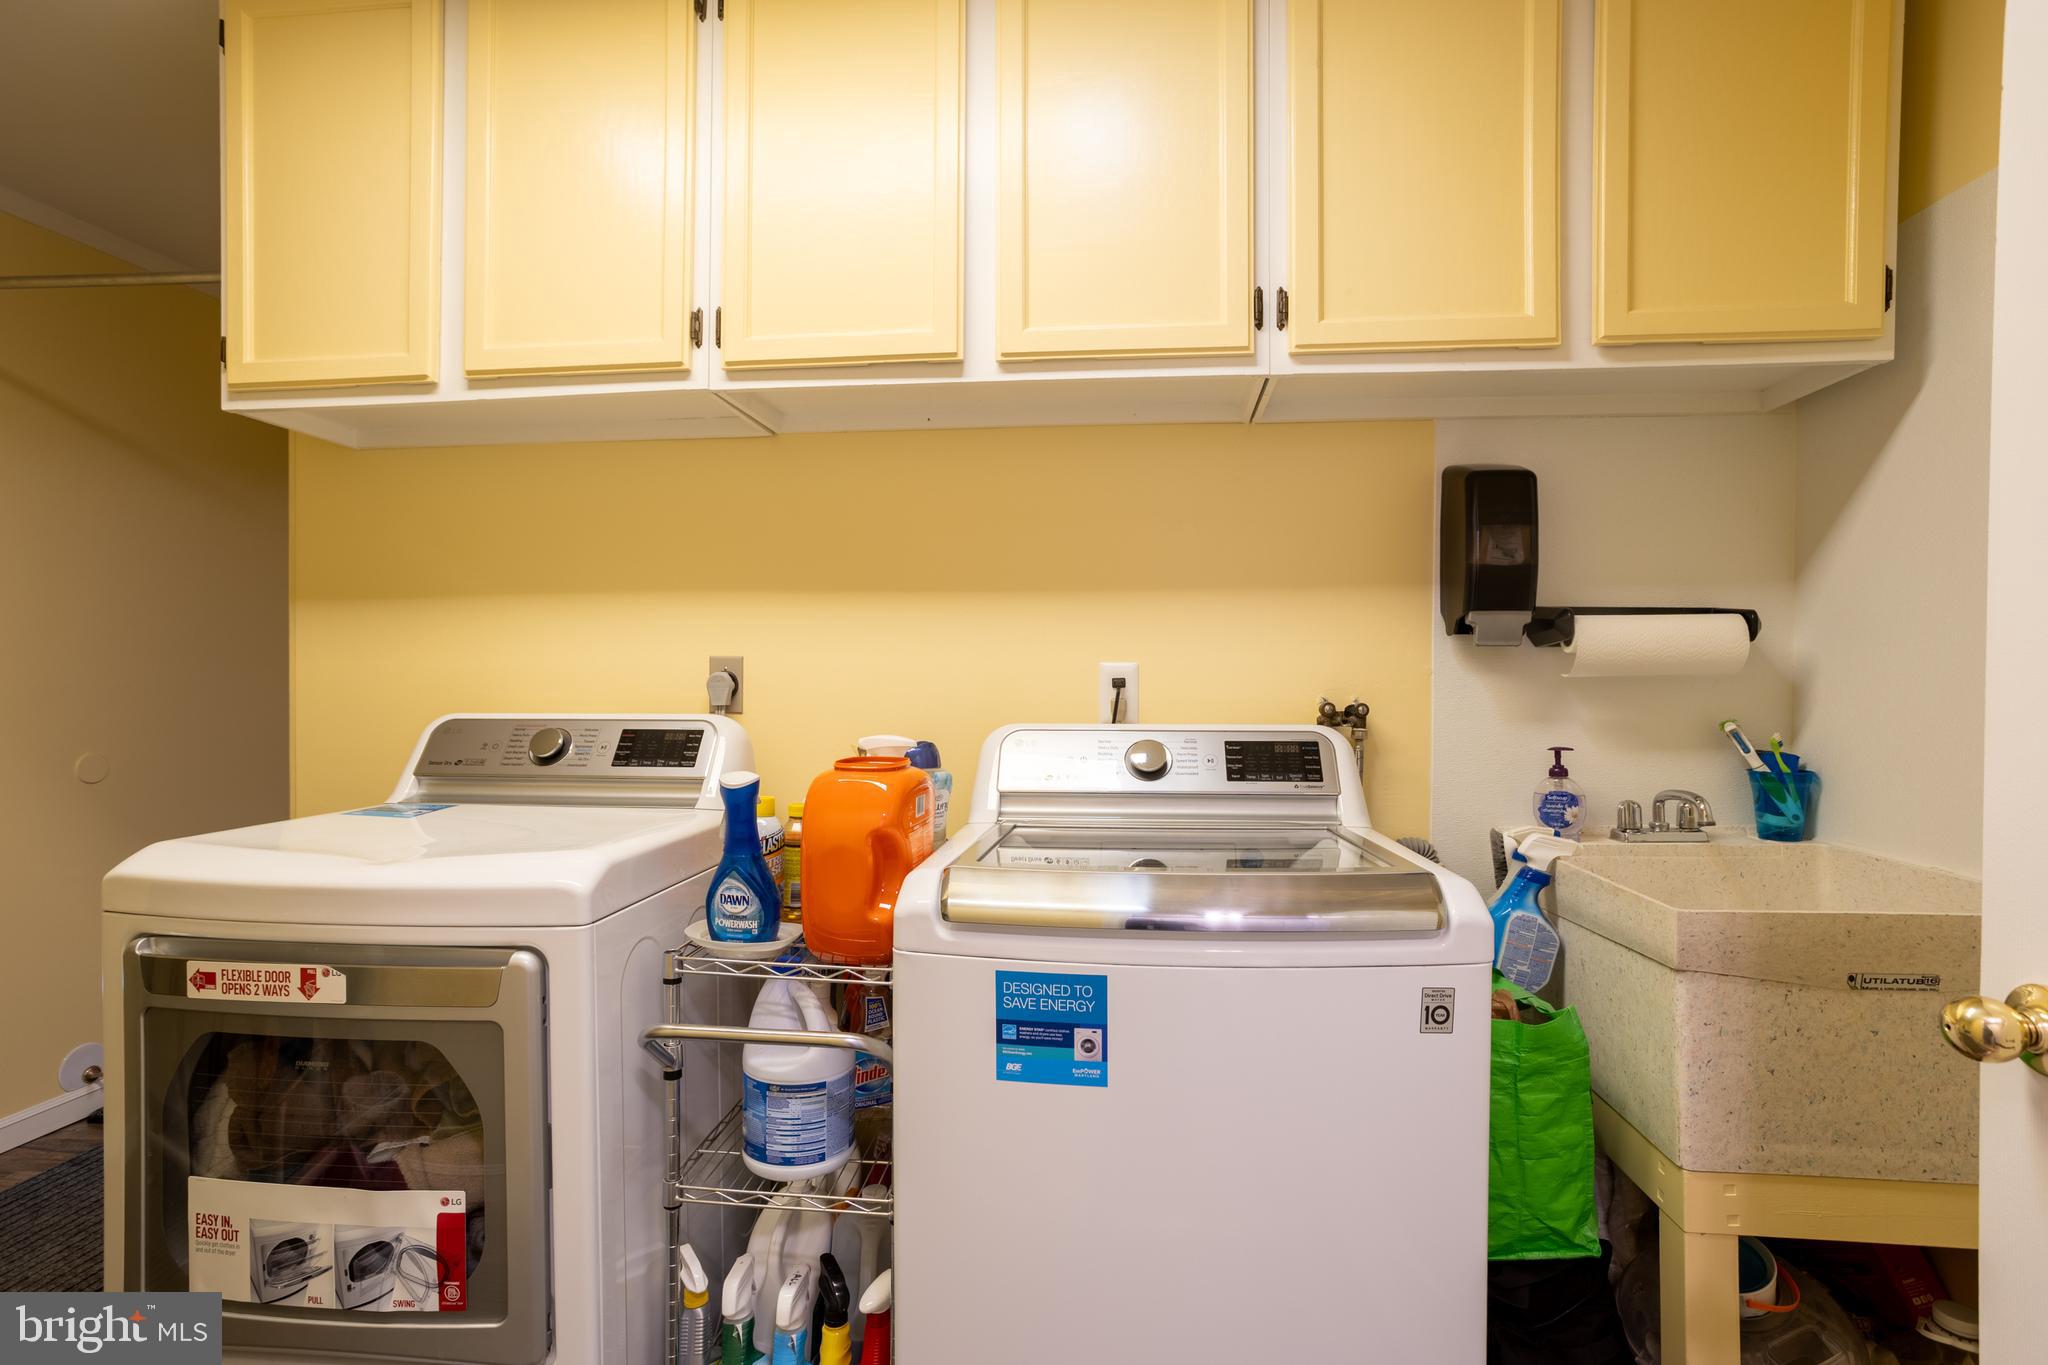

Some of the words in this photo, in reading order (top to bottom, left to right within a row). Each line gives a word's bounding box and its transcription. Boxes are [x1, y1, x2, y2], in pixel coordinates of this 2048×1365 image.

[720, 893, 750, 906] DAWN
[714, 917, 758, 929] POWERWASH
[221, 968, 263, 983] FLEXIBLE
[265, 970, 291, 984] DOOR
[221, 982, 252, 995] OPENS
[254, 984, 260, 996] 2
[262, 984, 290, 997] WAYS
[1003, 981, 1071, 997] DESIGNED
[1074, 985, 1093, 998] TO
[1003, 996, 1037, 1010] SAVE
[1040, 999, 1095, 1013] ENERGY
[855, 1064, 890, 1087] inde
[451, 1198, 462, 1206] LG
[195, 1212, 219, 1227] EASY
[221, 1215, 233, 1229] IN,
[195, 1226, 219, 1240] EASY
[221, 1228, 240, 1242] OUT
[307, 1296, 323, 1305] PULL
[392, 1299, 416, 1308] SWING
